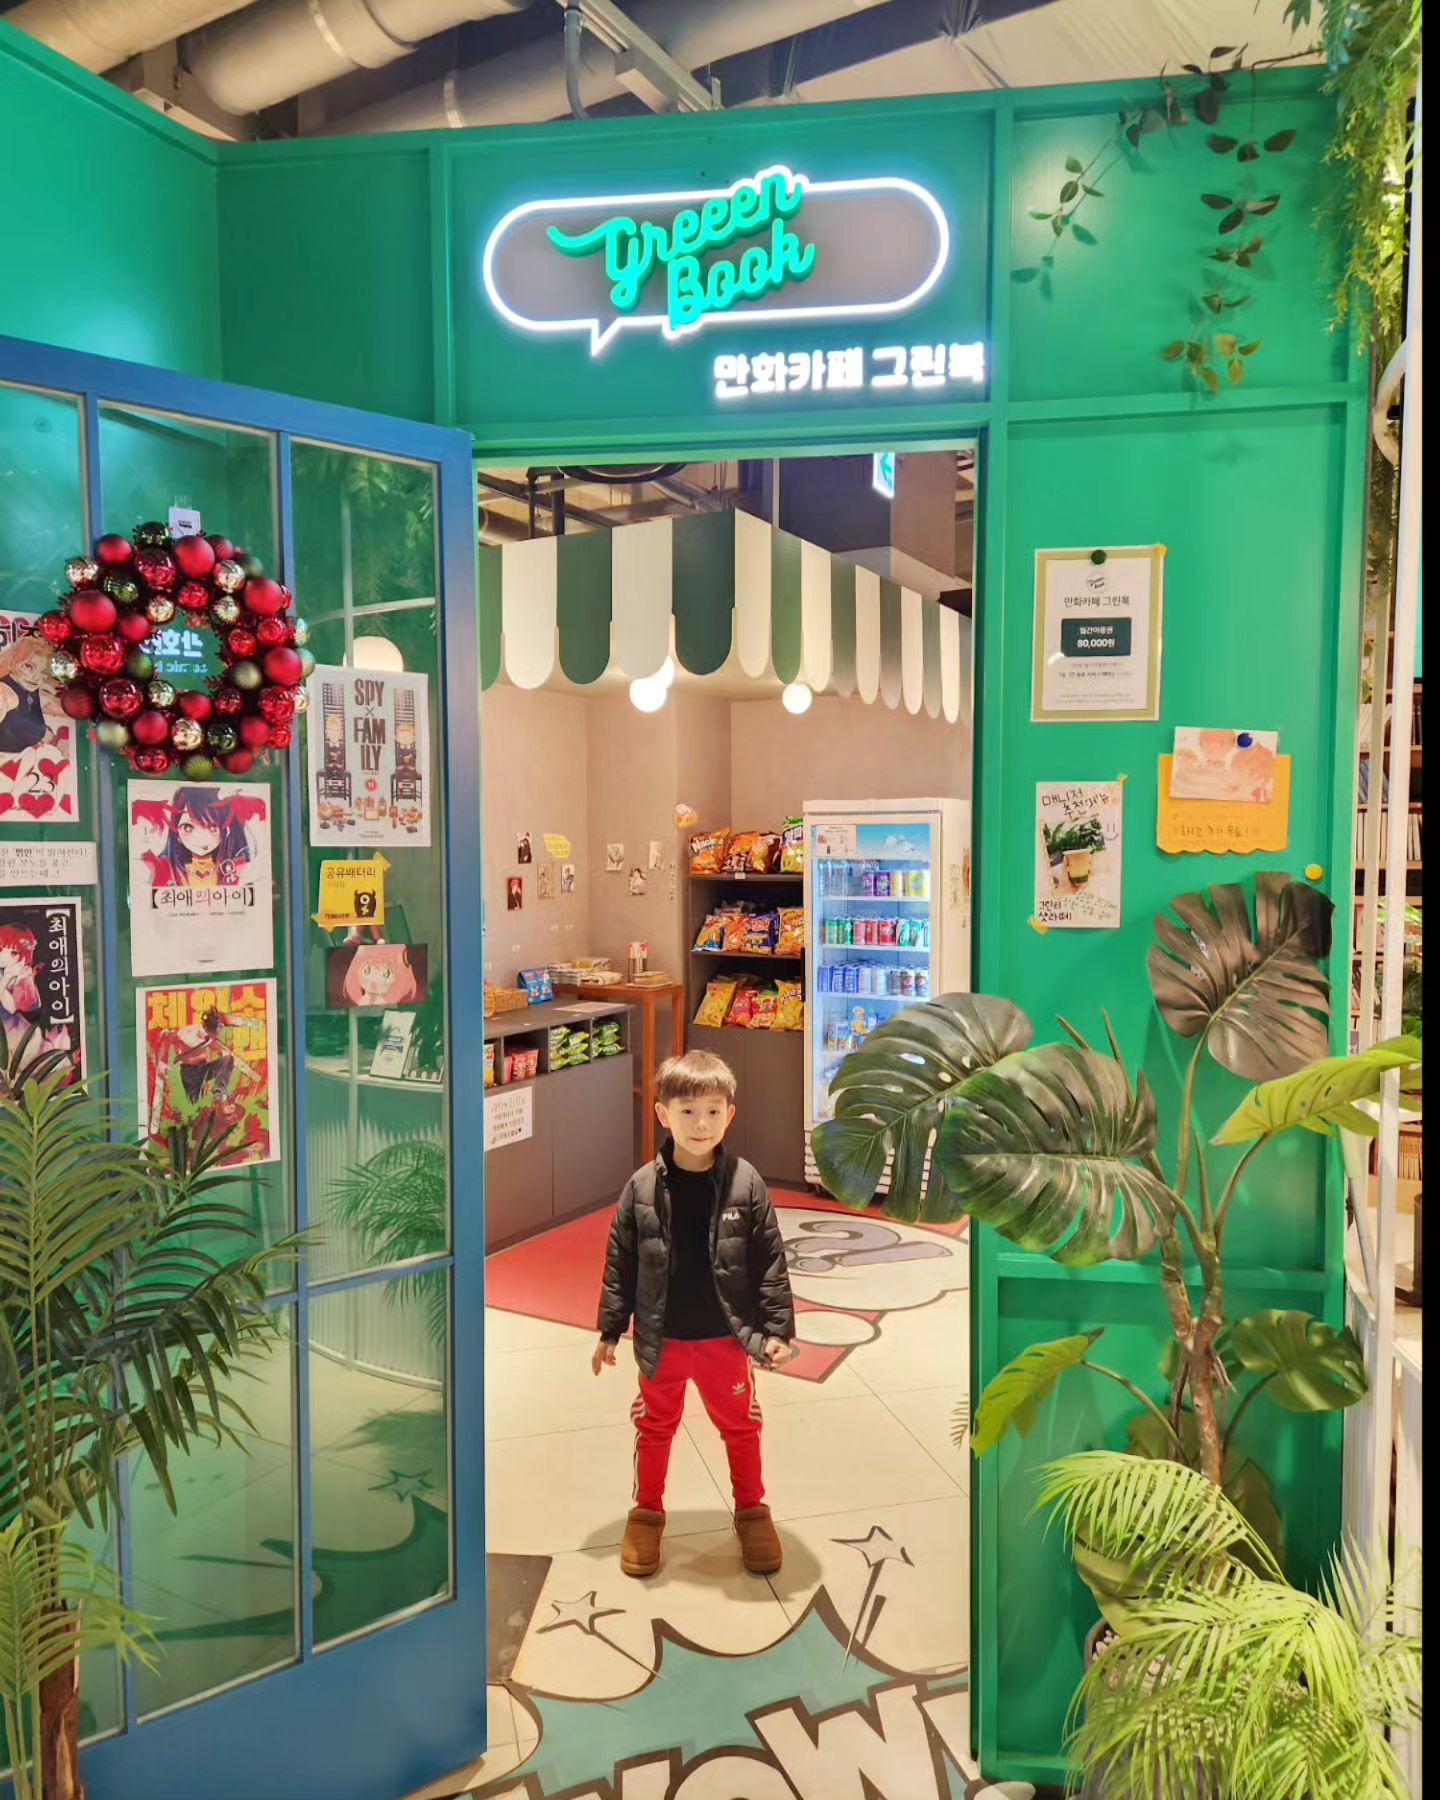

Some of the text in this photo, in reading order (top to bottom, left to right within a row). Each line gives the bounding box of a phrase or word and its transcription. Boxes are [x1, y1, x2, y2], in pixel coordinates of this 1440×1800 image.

[667, 217, 816, 331] Book
[713, 341, 985, 399] 만화카페 그린북
[1063, 596, 1101, 608] 만화카페
[1076, 638, 1115, 650] 80,000원
[354, 678, 385, 706] SPY
[353, 717, 386, 745] FAM
[360, 745, 382, 771] ILY
[326, 866, 376, 879] 공유배터리
[722, 1211, 741, 1222] FILA
